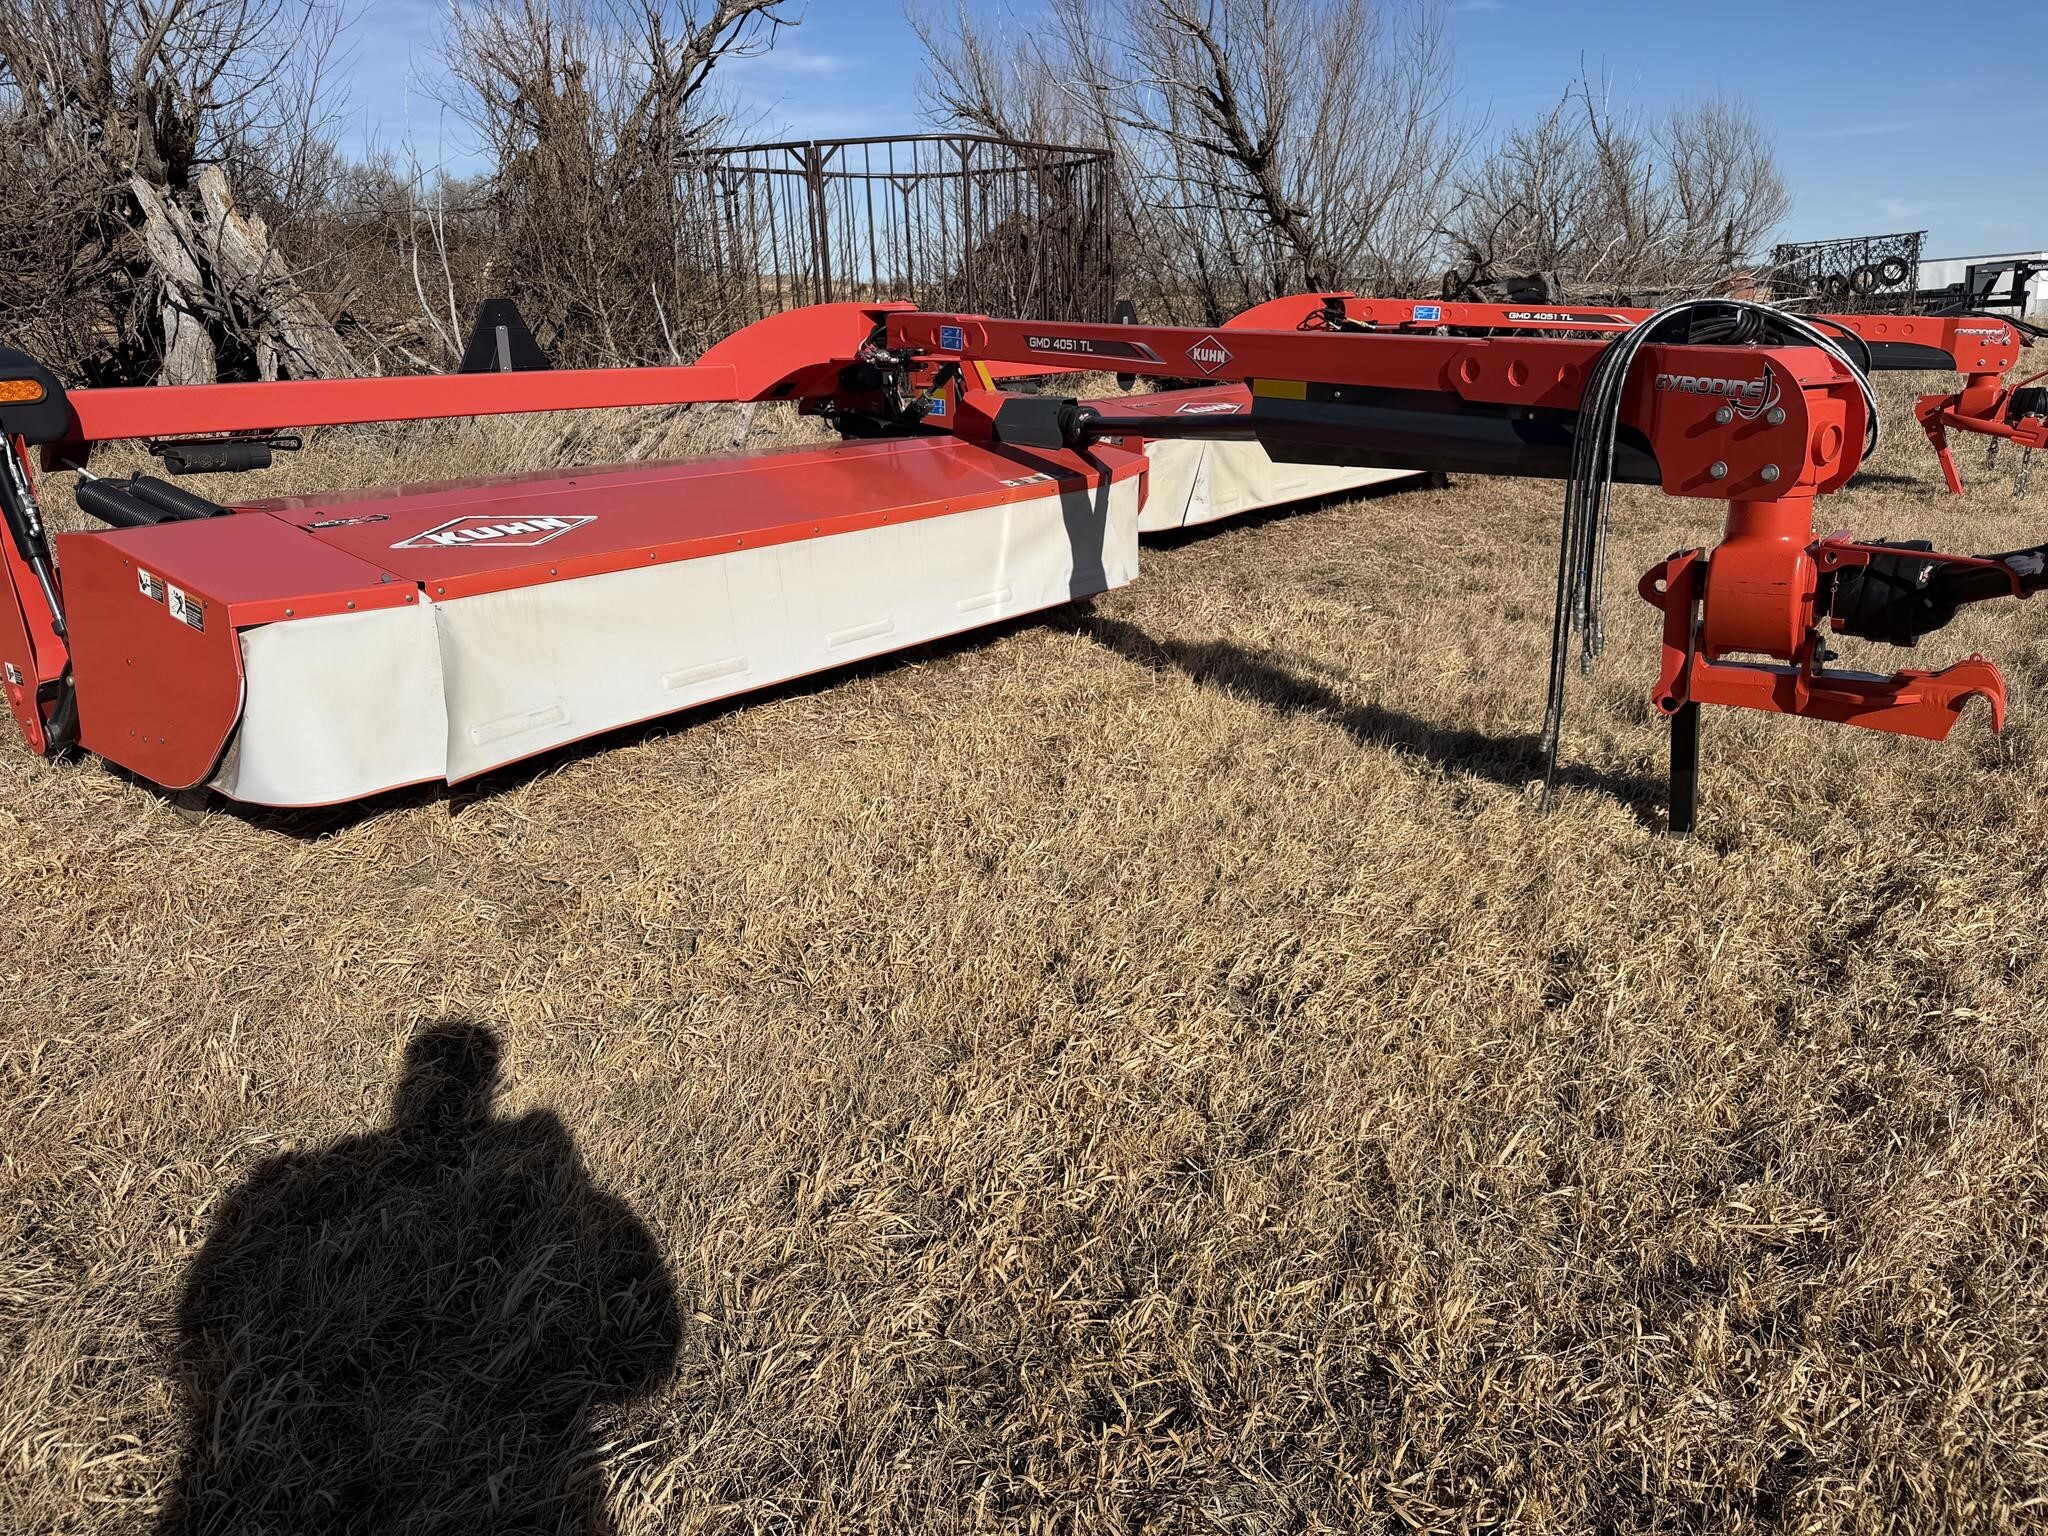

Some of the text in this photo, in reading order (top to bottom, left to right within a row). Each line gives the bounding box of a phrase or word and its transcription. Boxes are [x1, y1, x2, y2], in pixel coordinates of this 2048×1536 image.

[1508, 312, 1531, 320] GMD
[1560, 313, 1573, 321] TL
[1029, 336, 1093, 352] GMD 4051 TL
[1193, 347, 1226, 363] KUHN
[1655, 373, 1765, 400] GYRODINE
[424, 517, 573, 545] KUHN
